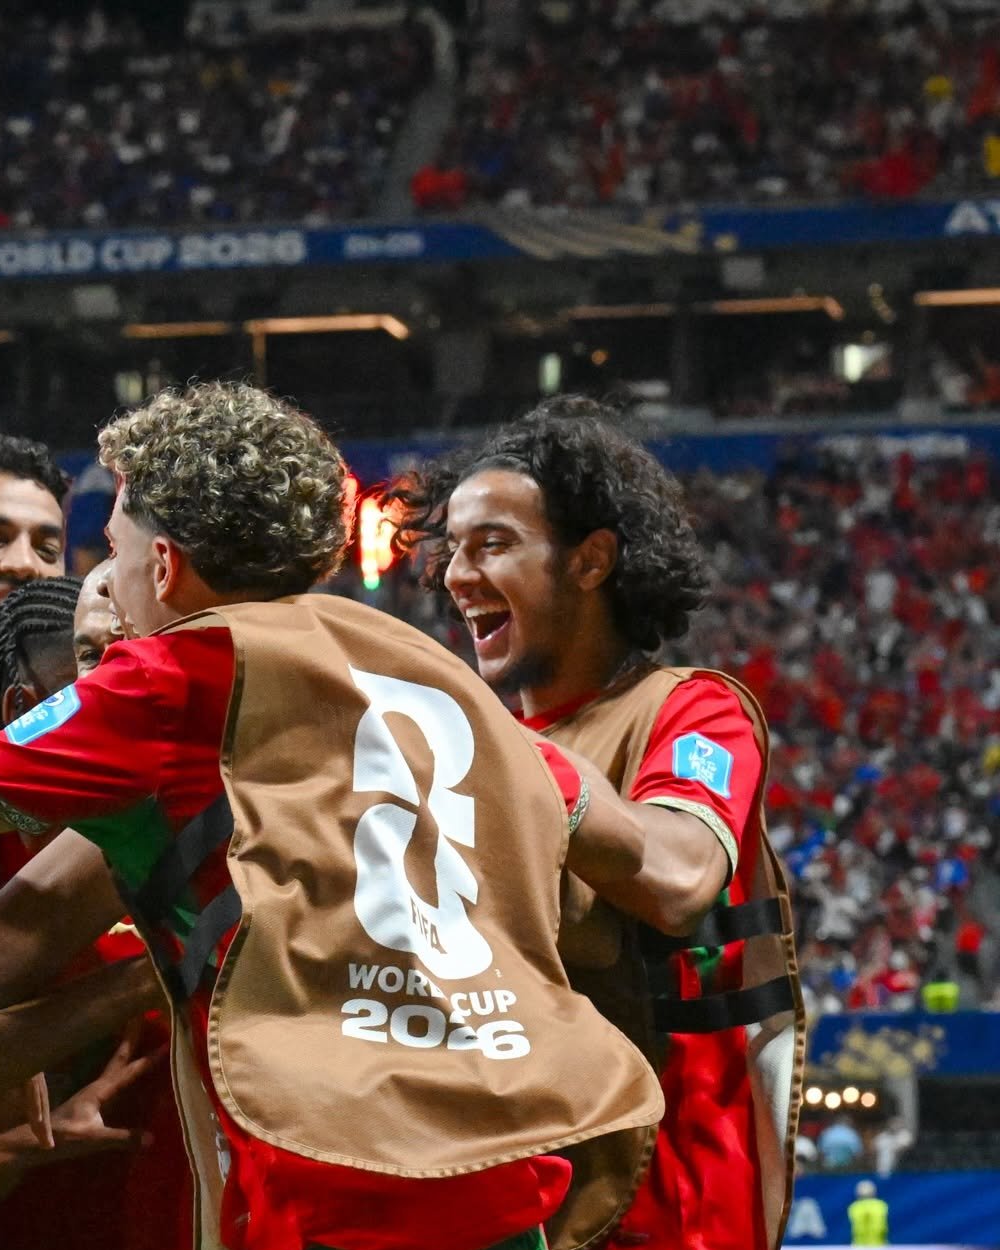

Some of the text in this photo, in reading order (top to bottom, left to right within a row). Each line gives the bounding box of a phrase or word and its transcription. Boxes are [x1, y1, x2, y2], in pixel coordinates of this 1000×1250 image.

[101, 235, 174, 270] CUP
[410, 896, 448, 955] FIFA
[450, 989, 517, 1018] CUP
